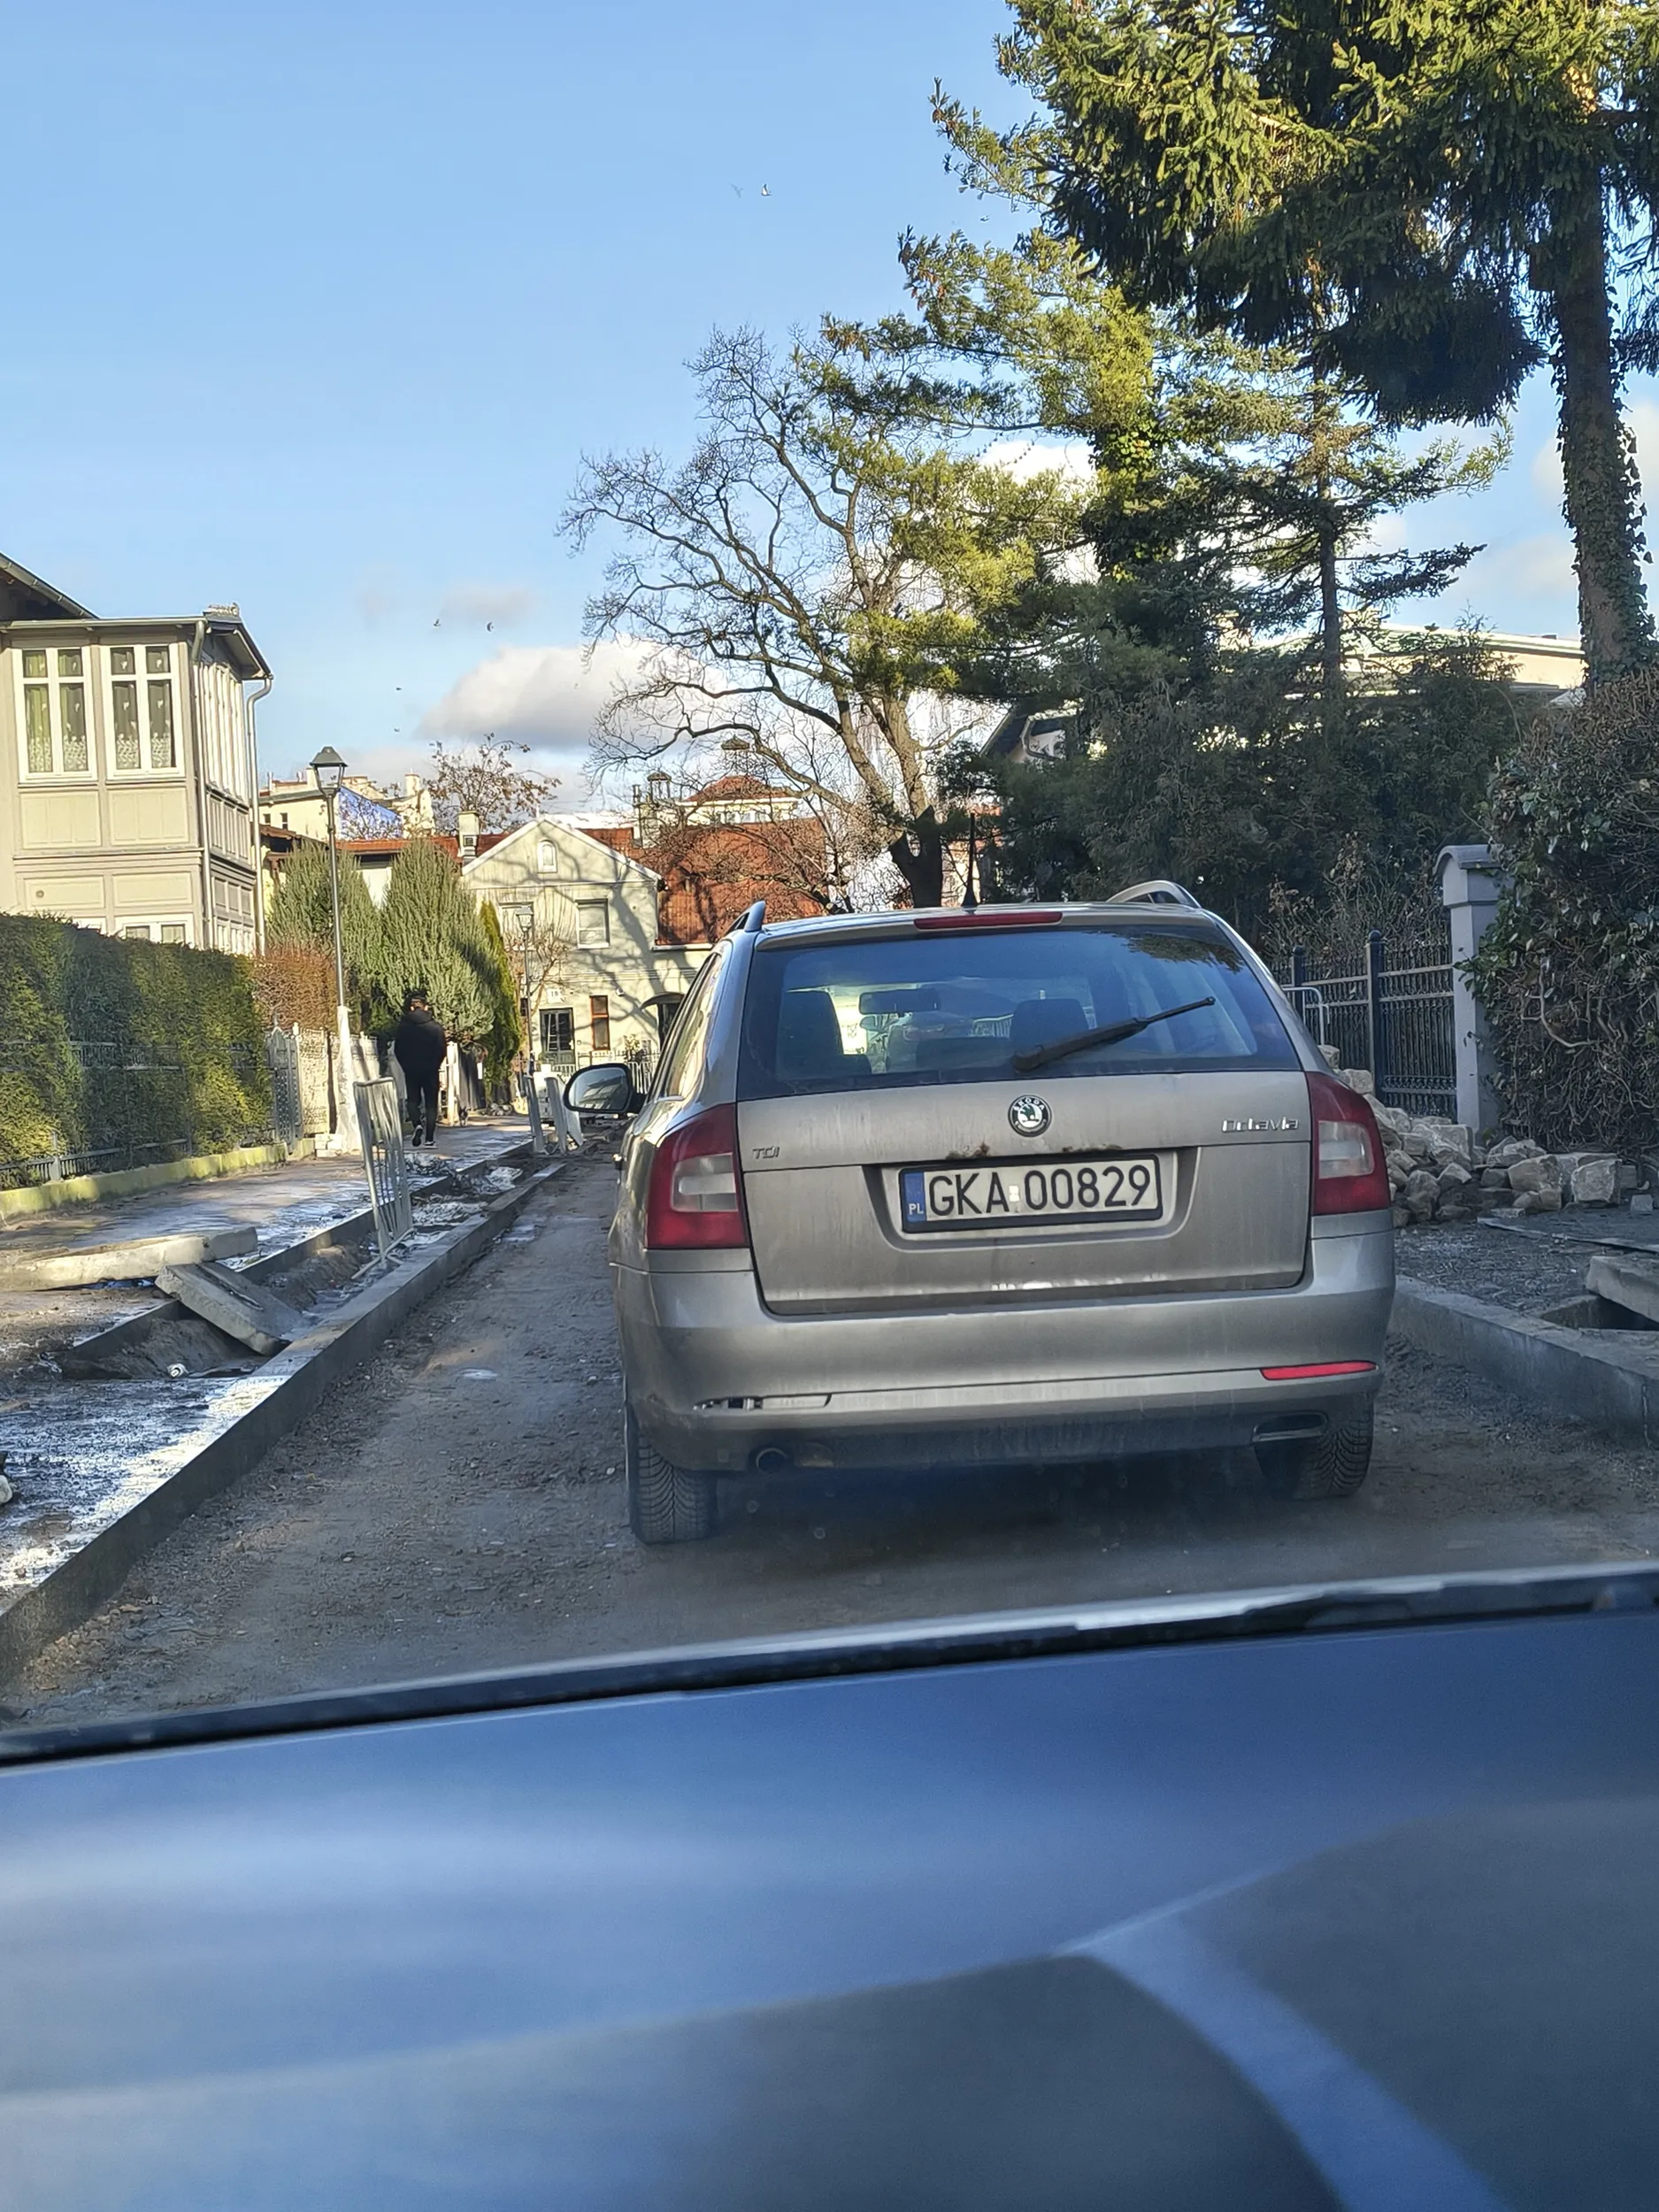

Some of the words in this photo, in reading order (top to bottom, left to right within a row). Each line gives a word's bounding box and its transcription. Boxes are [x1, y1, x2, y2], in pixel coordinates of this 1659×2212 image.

[752, 1146, 780, 1159] TDI
[928, 1171, 1010, 1217] GKA
[1024, 1164, 1151, 1211] 00829
[909, 1202, 924, 1216] PL
